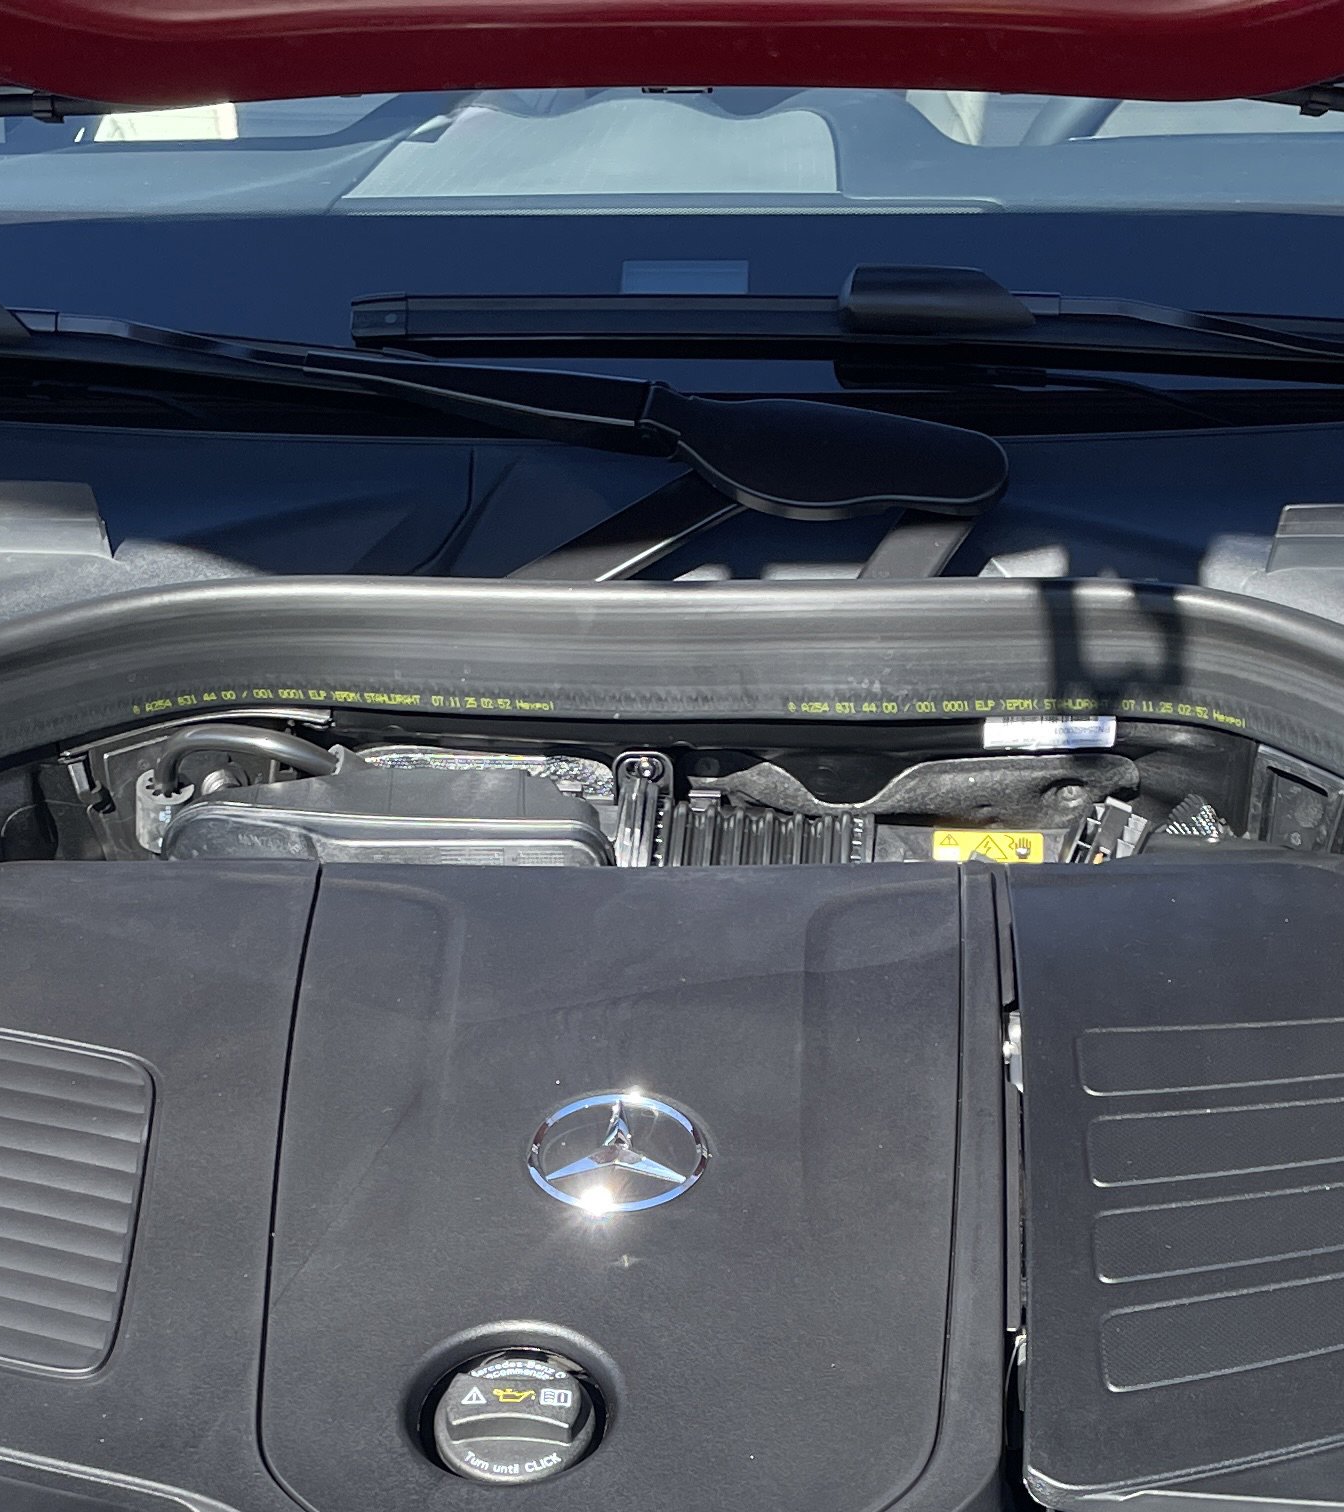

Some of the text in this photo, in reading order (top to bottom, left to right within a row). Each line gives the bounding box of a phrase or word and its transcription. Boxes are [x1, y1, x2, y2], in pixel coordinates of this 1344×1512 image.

[1212, 709, 1246, 729] Hexpol
[464, 1450, 562, 1475] Turn until CLICK
